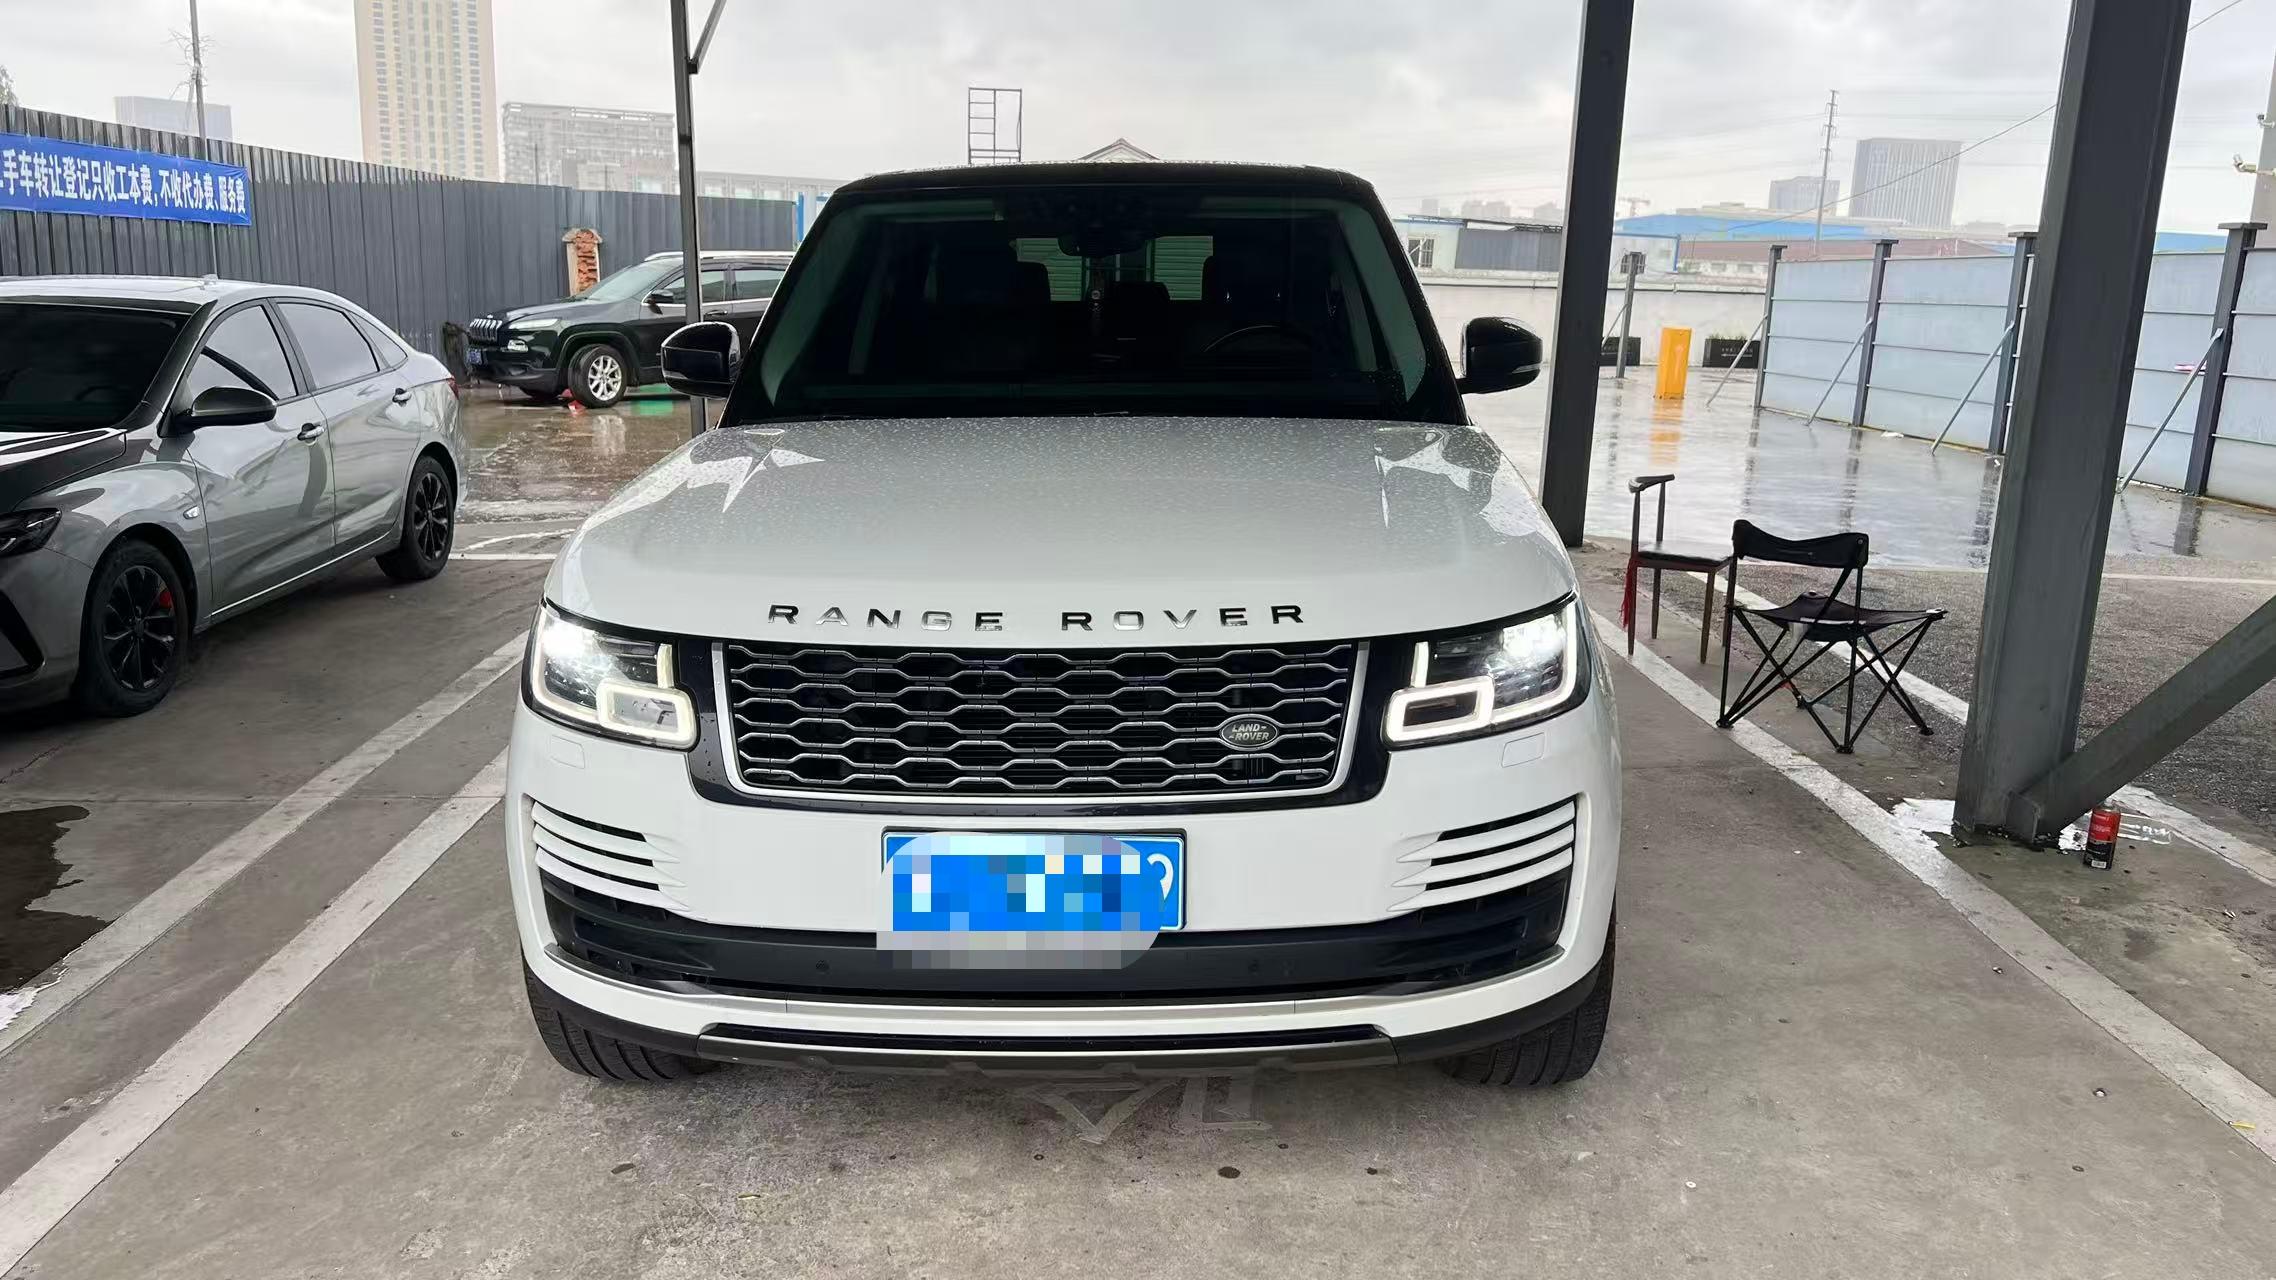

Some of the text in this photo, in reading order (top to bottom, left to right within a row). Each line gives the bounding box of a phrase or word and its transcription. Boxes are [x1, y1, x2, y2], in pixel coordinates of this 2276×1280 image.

[0, 149, 246, 214] 手车转让登记只收工本费，不收代办费、服务费
[768, 604, 1304, 631] RANGE ROVER
[1232, 723, 1260, 732] LAND
[1234, 732, 1269, 741] ROVER
